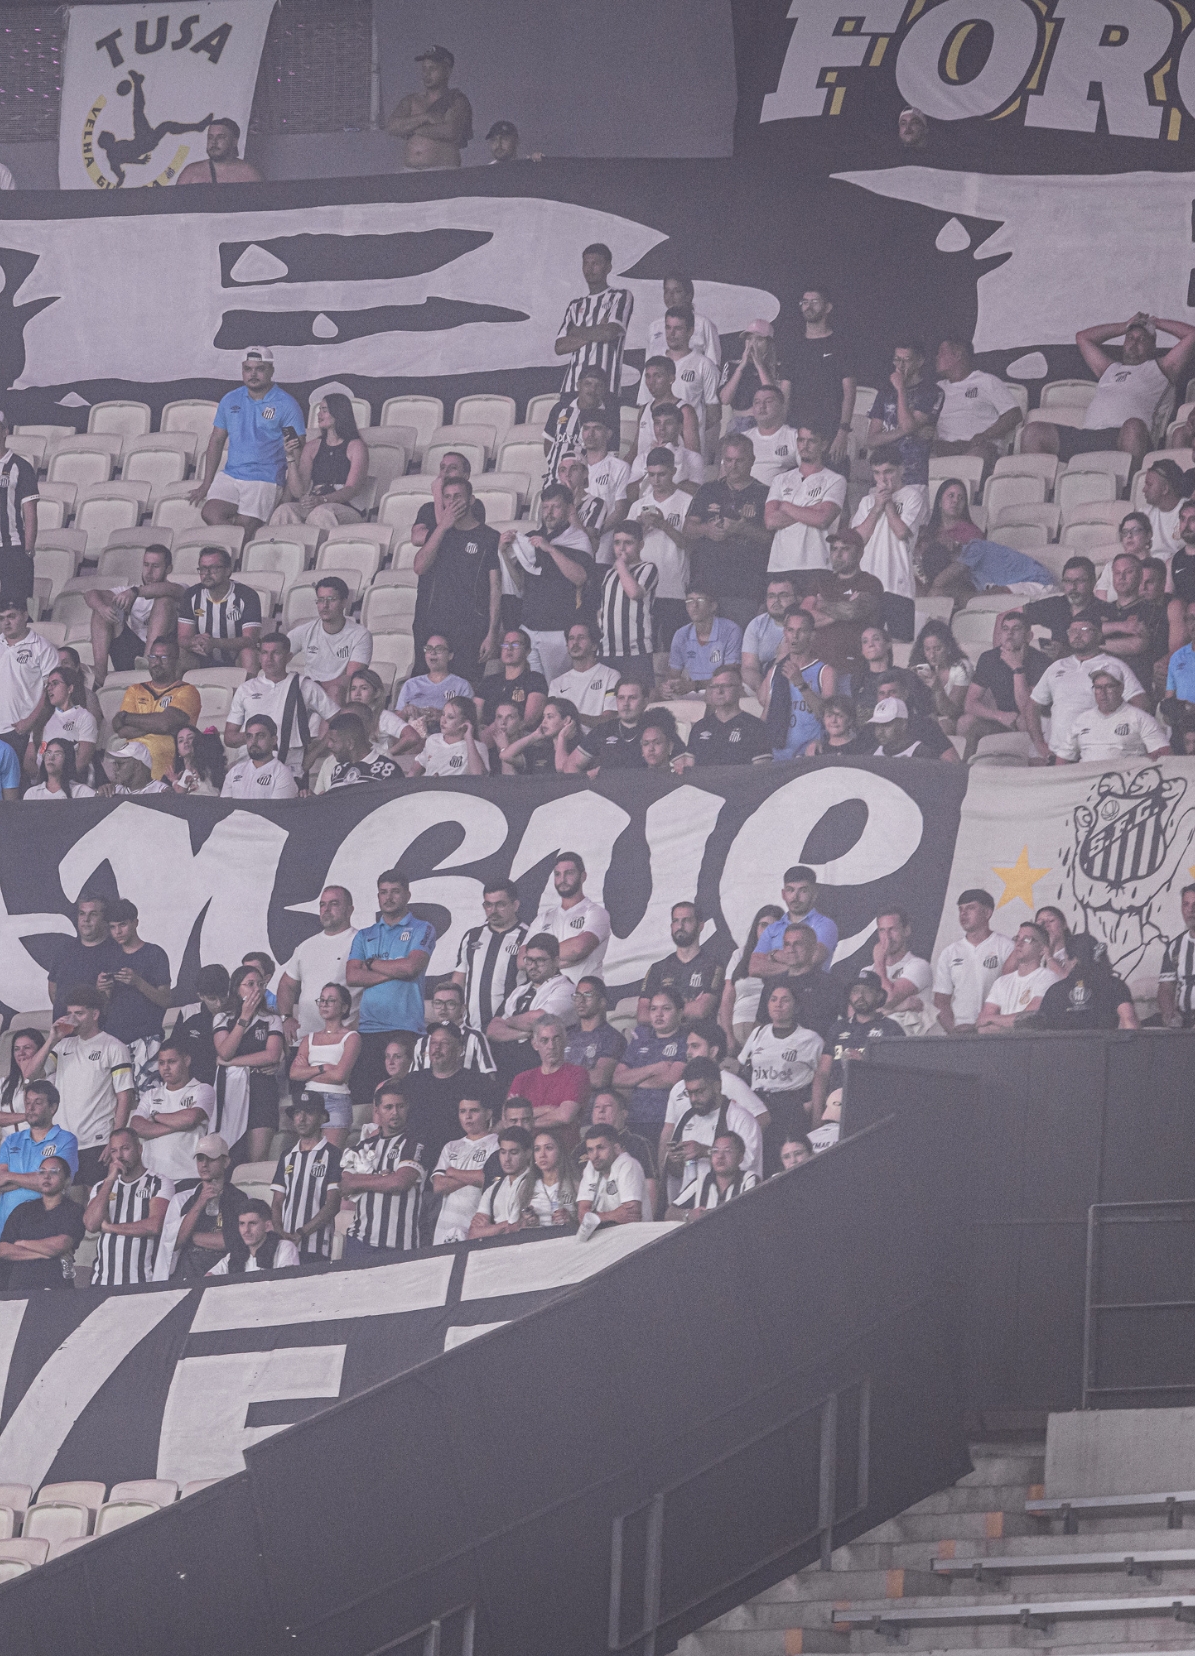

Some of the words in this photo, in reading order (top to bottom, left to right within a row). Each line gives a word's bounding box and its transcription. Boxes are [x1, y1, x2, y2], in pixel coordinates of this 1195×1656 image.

[95, 14, 233, 69] TUSA
[759, 0, 1195, 140] FOR
[83, 107, 103, 168] VELHA
[370, 761, 396, 777] 88
